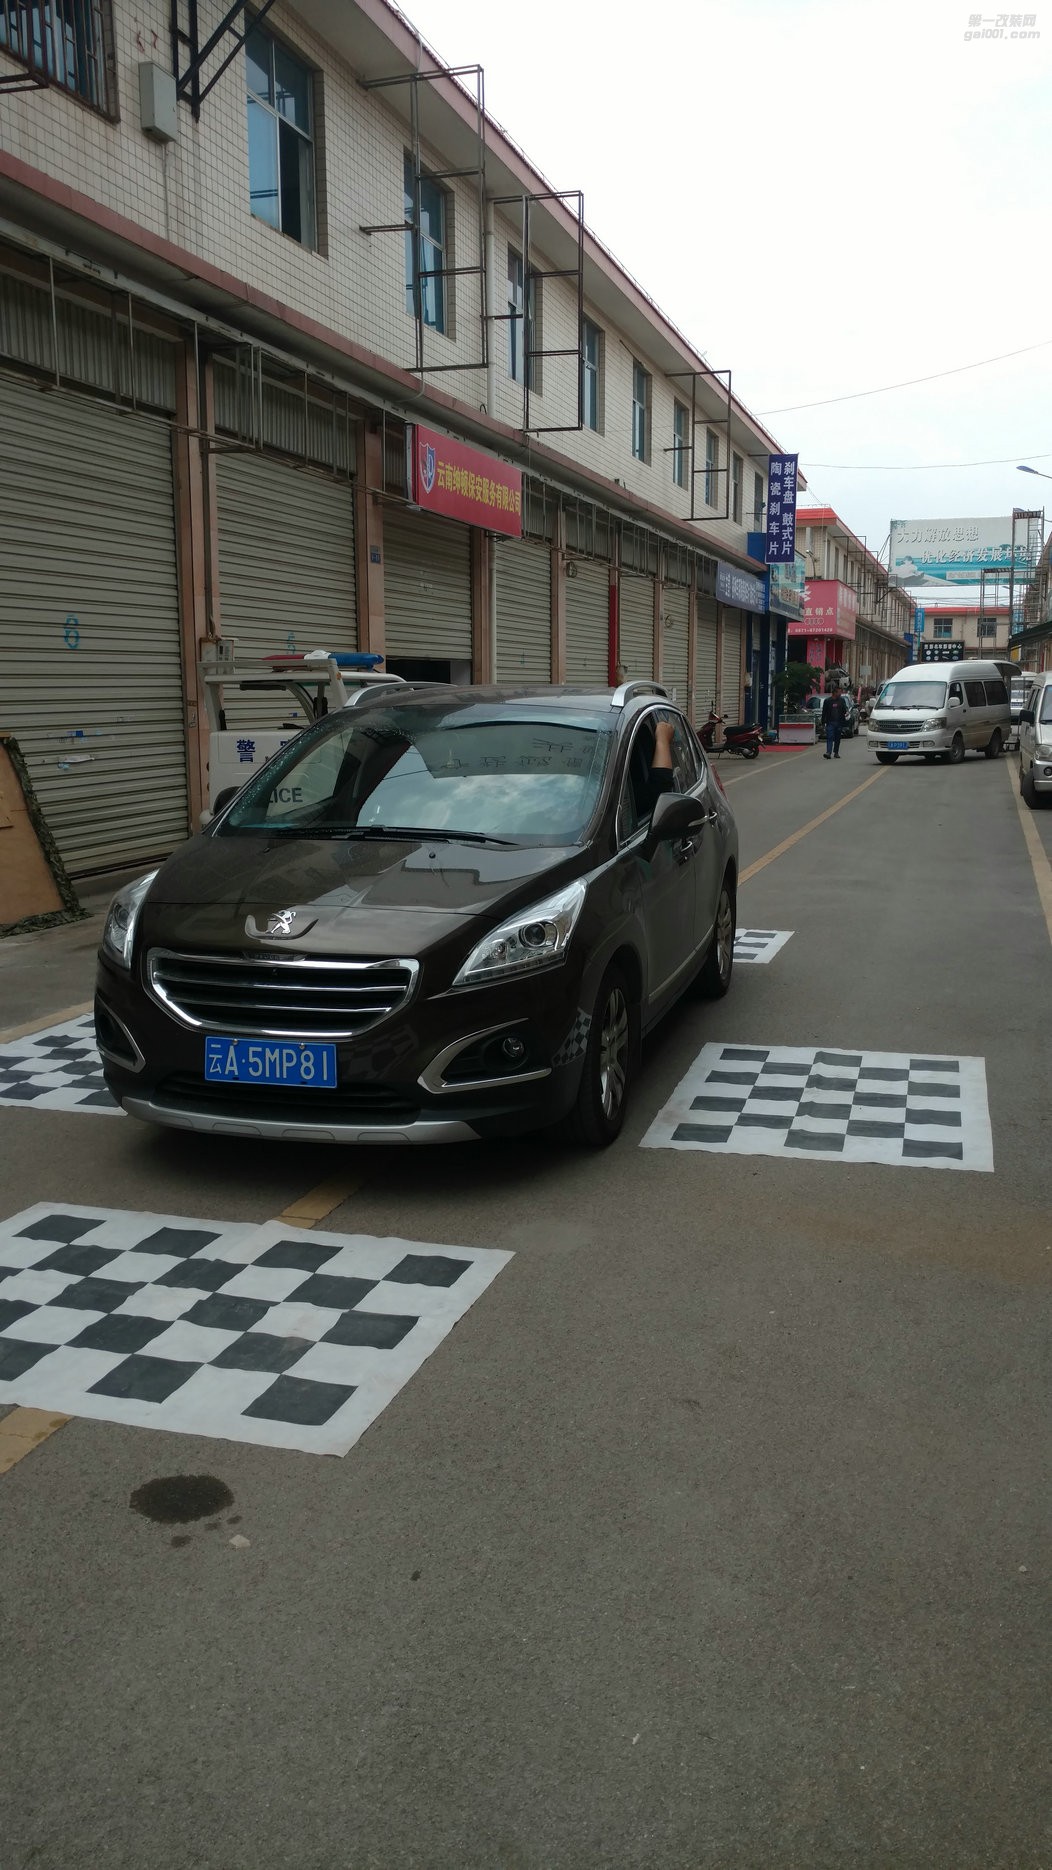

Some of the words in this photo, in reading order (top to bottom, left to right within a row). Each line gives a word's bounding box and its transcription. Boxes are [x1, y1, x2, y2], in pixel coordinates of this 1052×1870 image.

[768, 462, 782, 555] 陶瓷刹车片
[897, 527, 979, 544] 大力解放思想
[209, 1044, 328, 1081] 云A·5MP81
